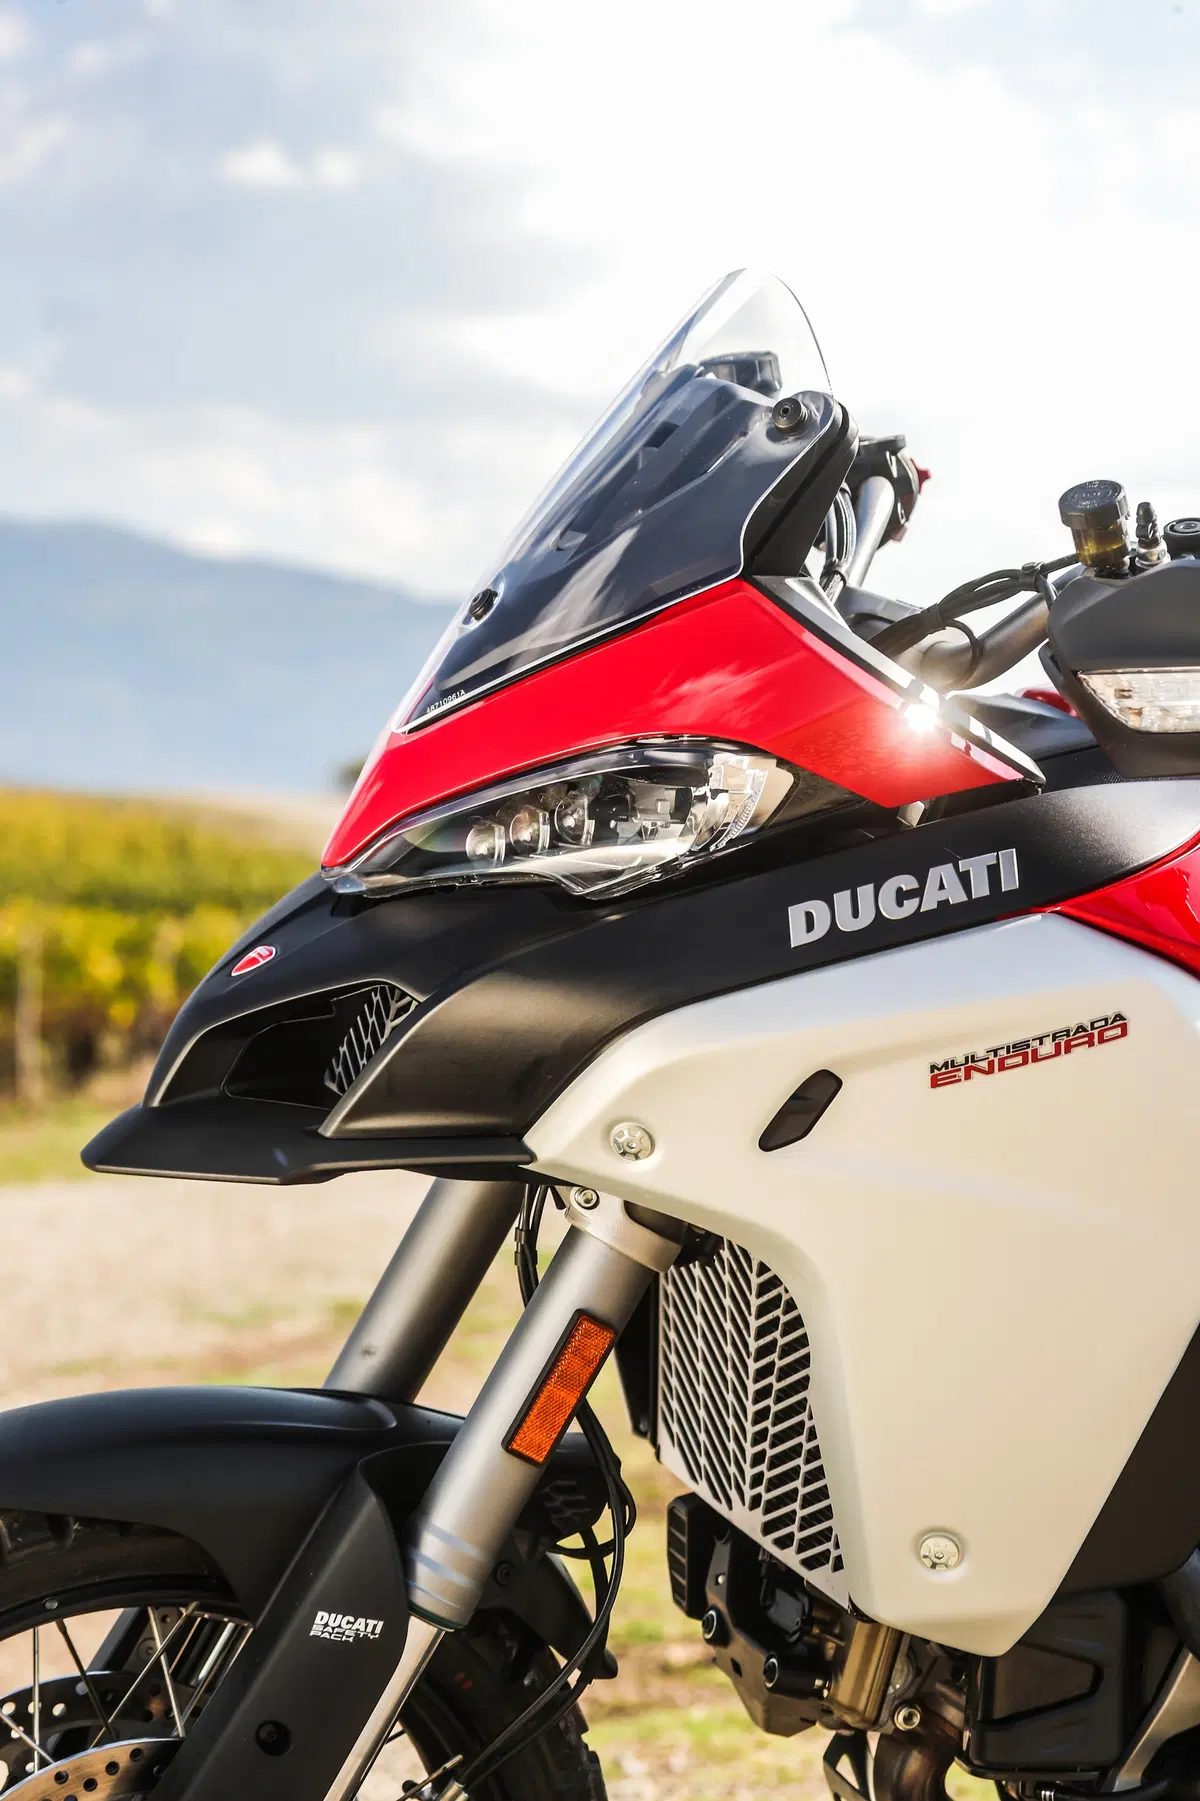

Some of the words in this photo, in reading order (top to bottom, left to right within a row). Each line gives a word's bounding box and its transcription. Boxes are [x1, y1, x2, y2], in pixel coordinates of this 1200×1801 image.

[788, 848, 1019, 948] DUCATI
[929, 1011, 1128, 1074] MULTISTRADA
[930, 1022, 1128, 1088] ENDURO
[310, 1630, 354, 1642] PACK
[311, 1624, 379, 1639] SAFETY
[314, 1611, 384, 1633] DUCATI
